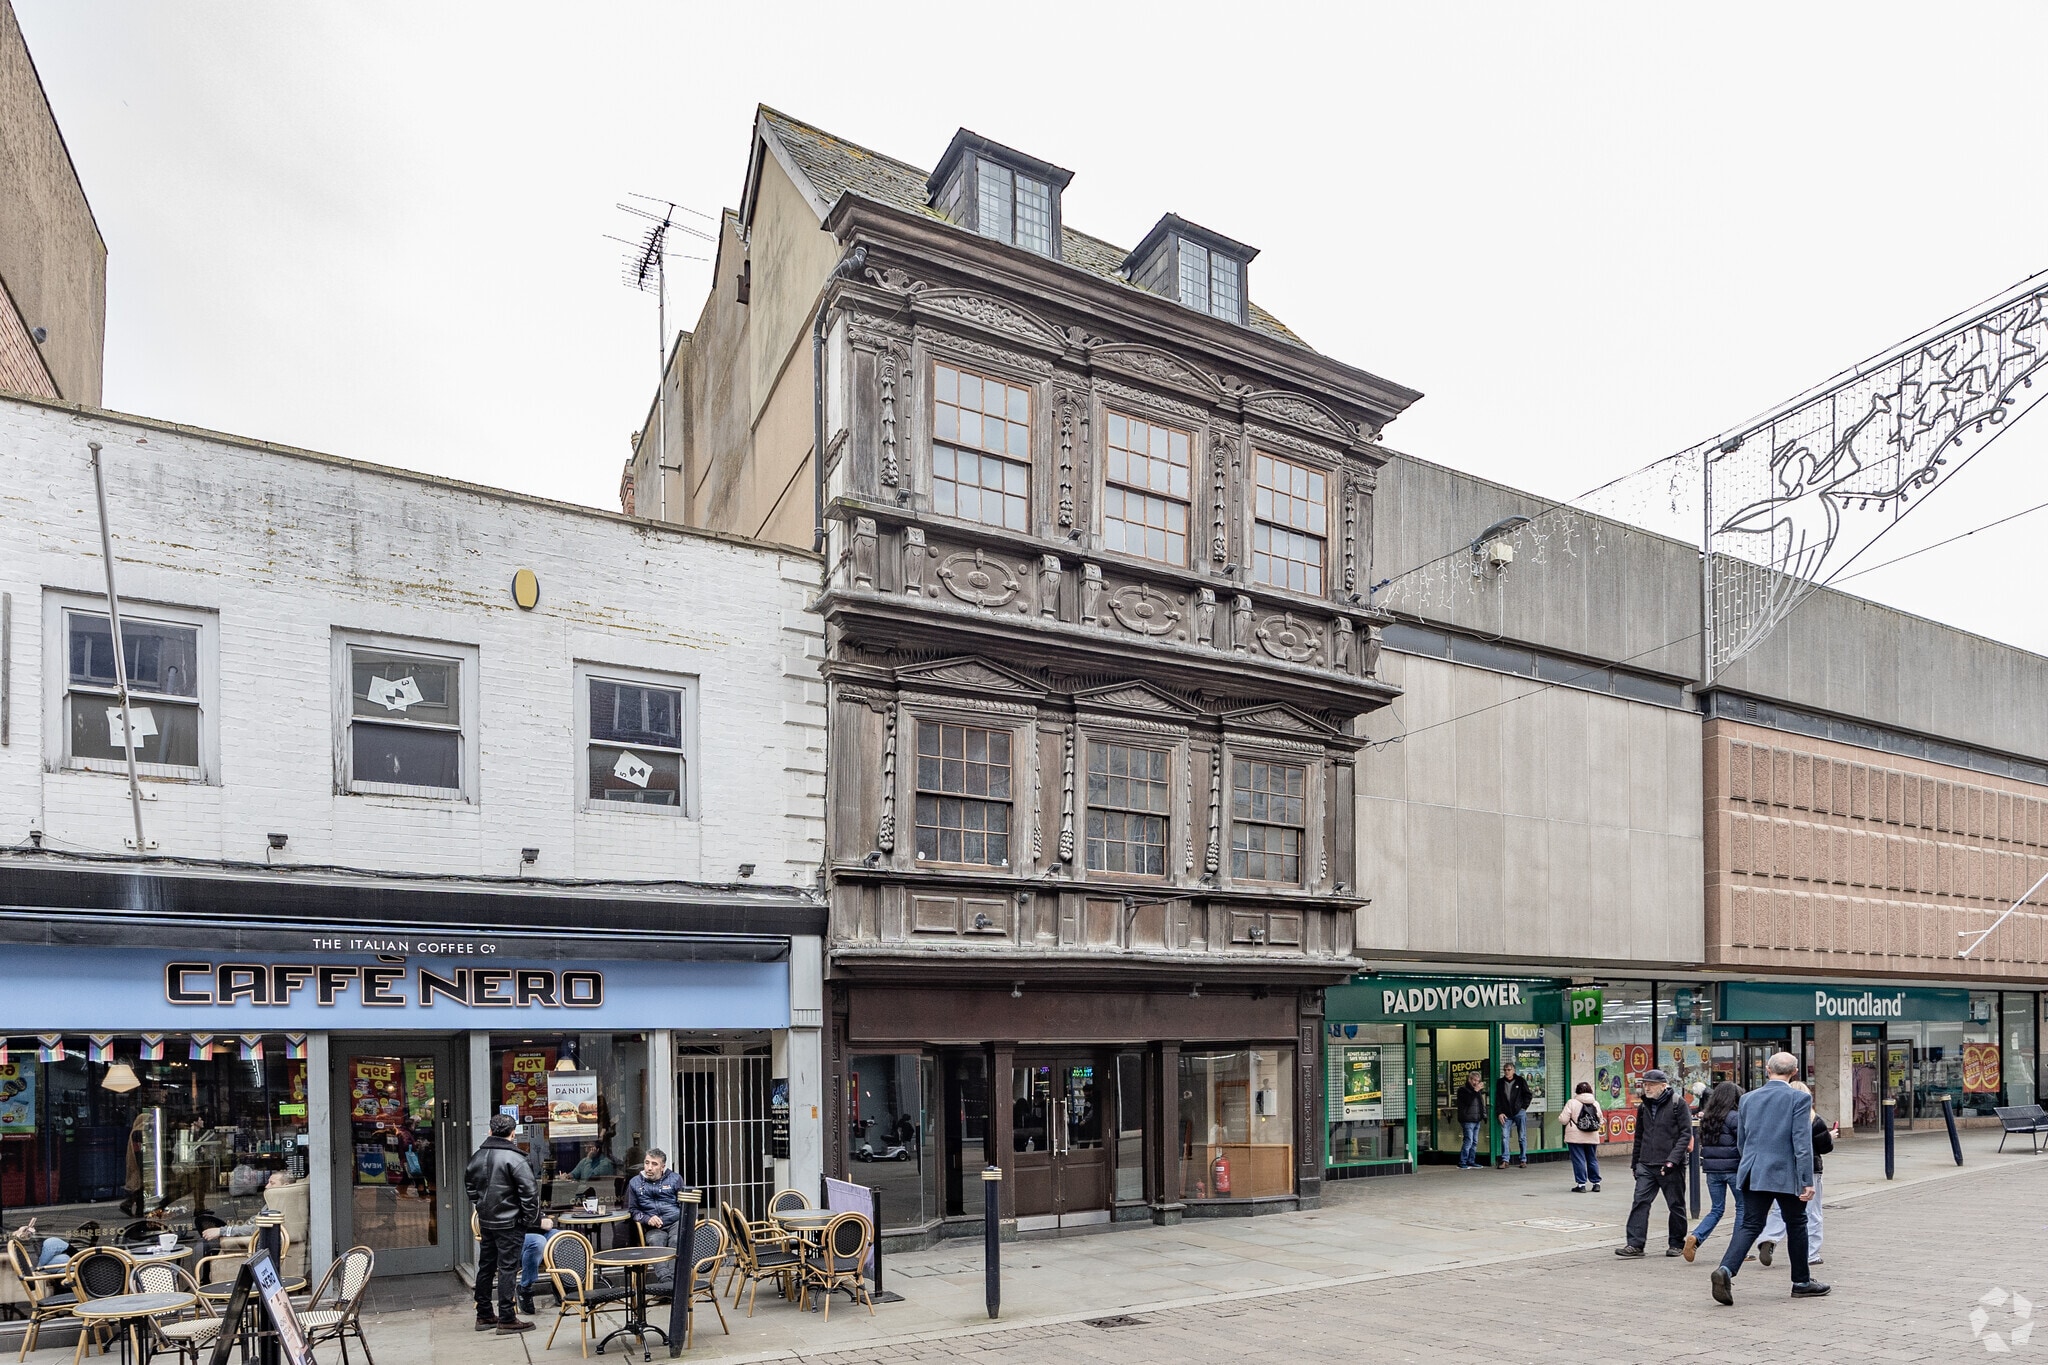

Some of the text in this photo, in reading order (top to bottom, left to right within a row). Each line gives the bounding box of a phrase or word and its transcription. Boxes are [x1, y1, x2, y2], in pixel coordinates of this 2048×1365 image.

[312, 938, 342, 951] THE
[349, 939, 409, 953] ITALIAN
[417, 941, 475, 954] COFFEE
[418, 967, 605, 1009] NERO
[1633, 1052, 1645, 1066] £1
[1451, 1060, 1482, 1073] DEPOSIT
[555, 1087, 590, 1095] PANINI
[65, 1226, 126, 1238] ESPRESSO
[160, 1223, 194, 1233] LATTE
